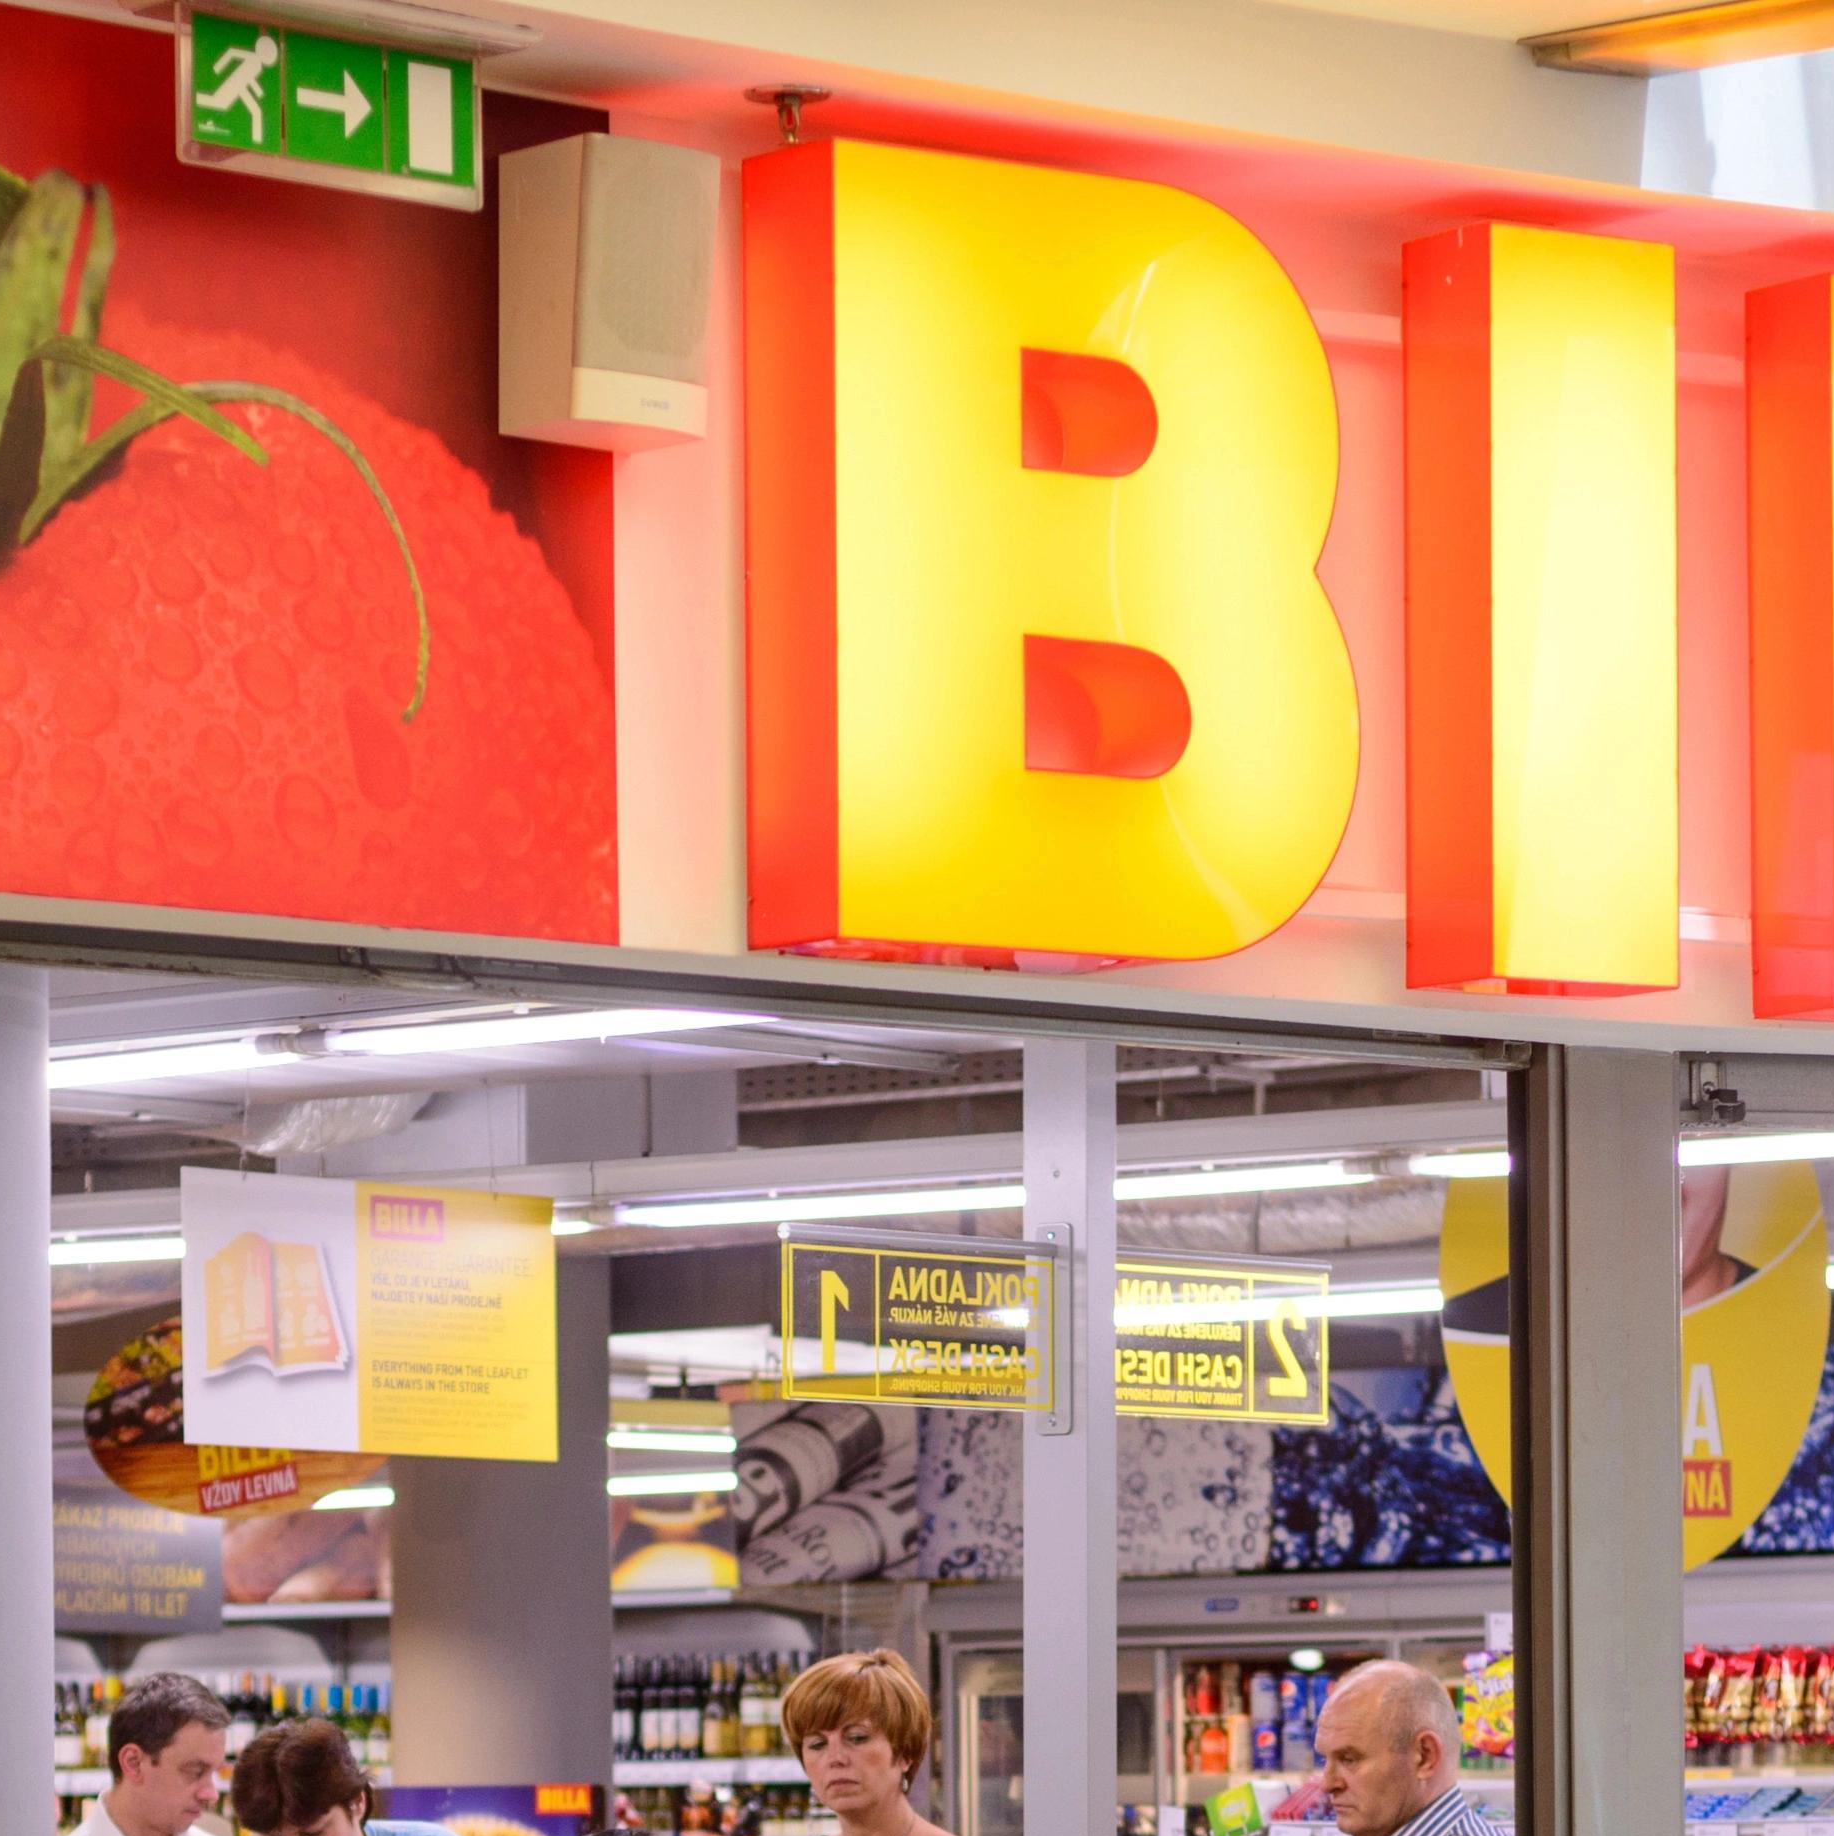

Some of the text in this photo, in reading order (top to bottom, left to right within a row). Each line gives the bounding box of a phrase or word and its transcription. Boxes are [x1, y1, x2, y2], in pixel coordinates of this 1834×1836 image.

[374, 1203, 440, 1236] BILLA
[372, 1360, 529, 1380] EVERYTHING FROM THE LEAFLET
[383, 1377, 424, 1392] ALWAYS
[438, 1379, 456, 1393] THE
[459, 1380, 491, 1395] STORE
[200, 1466, 297, 1513] VŽDY LEVNÁ
